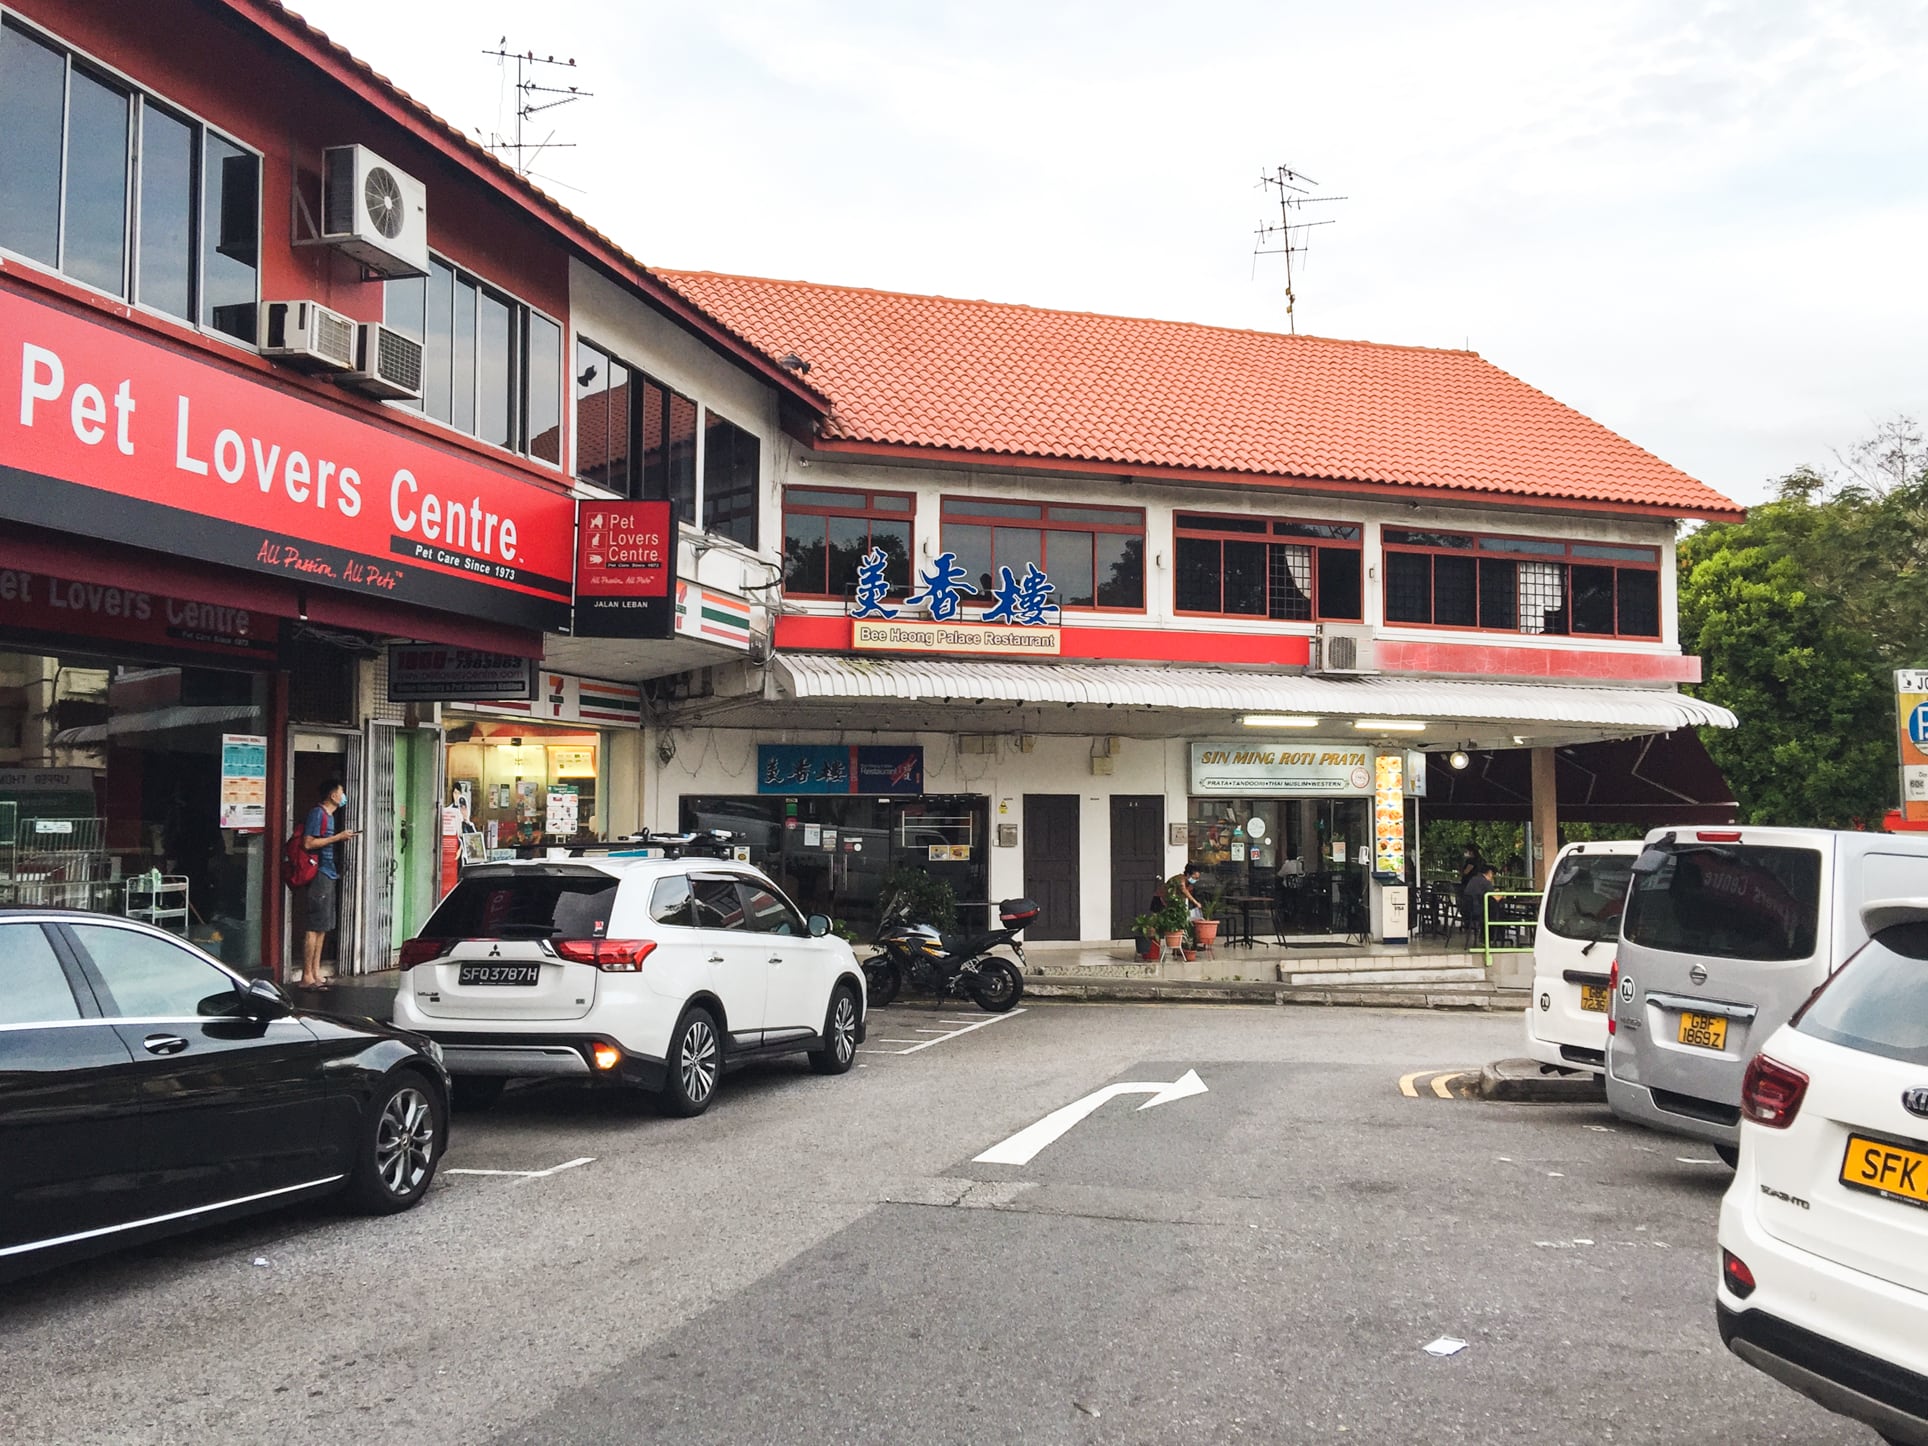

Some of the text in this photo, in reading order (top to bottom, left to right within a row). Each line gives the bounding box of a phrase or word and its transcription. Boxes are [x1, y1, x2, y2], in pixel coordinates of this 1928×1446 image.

[20, 341, 517, 561] Pet Lovers Centre
[610, 514, 634, 529] Pet
[609, 531, 659, 545] Lovers
[257, 539, 280, 564] All
[343, 560, 363, 582] All
[415, 544, 516, 581] Pet Care Since 1973
[609, 547, 658, 562] Centre
[50, 577, 151, 620] Lovers
[622, 601, 648, 609] LEBAN
[860, 627, 1055, 647] Bee Heong Palace Restaurant
[1202, 751, 1366, 766] SIN MING ROTI PRATA
[462, 967, 538, 982] SFQ3787H
[1623, 982, 1633, 996] 70
[1691, 1015, 1716, 1030] GBF
[1682, 1027, 1721, 1048] 1869Z
[1907, 1091, 1928, 1111] KI
[1861, 1148, 1922, 1191] SFK
